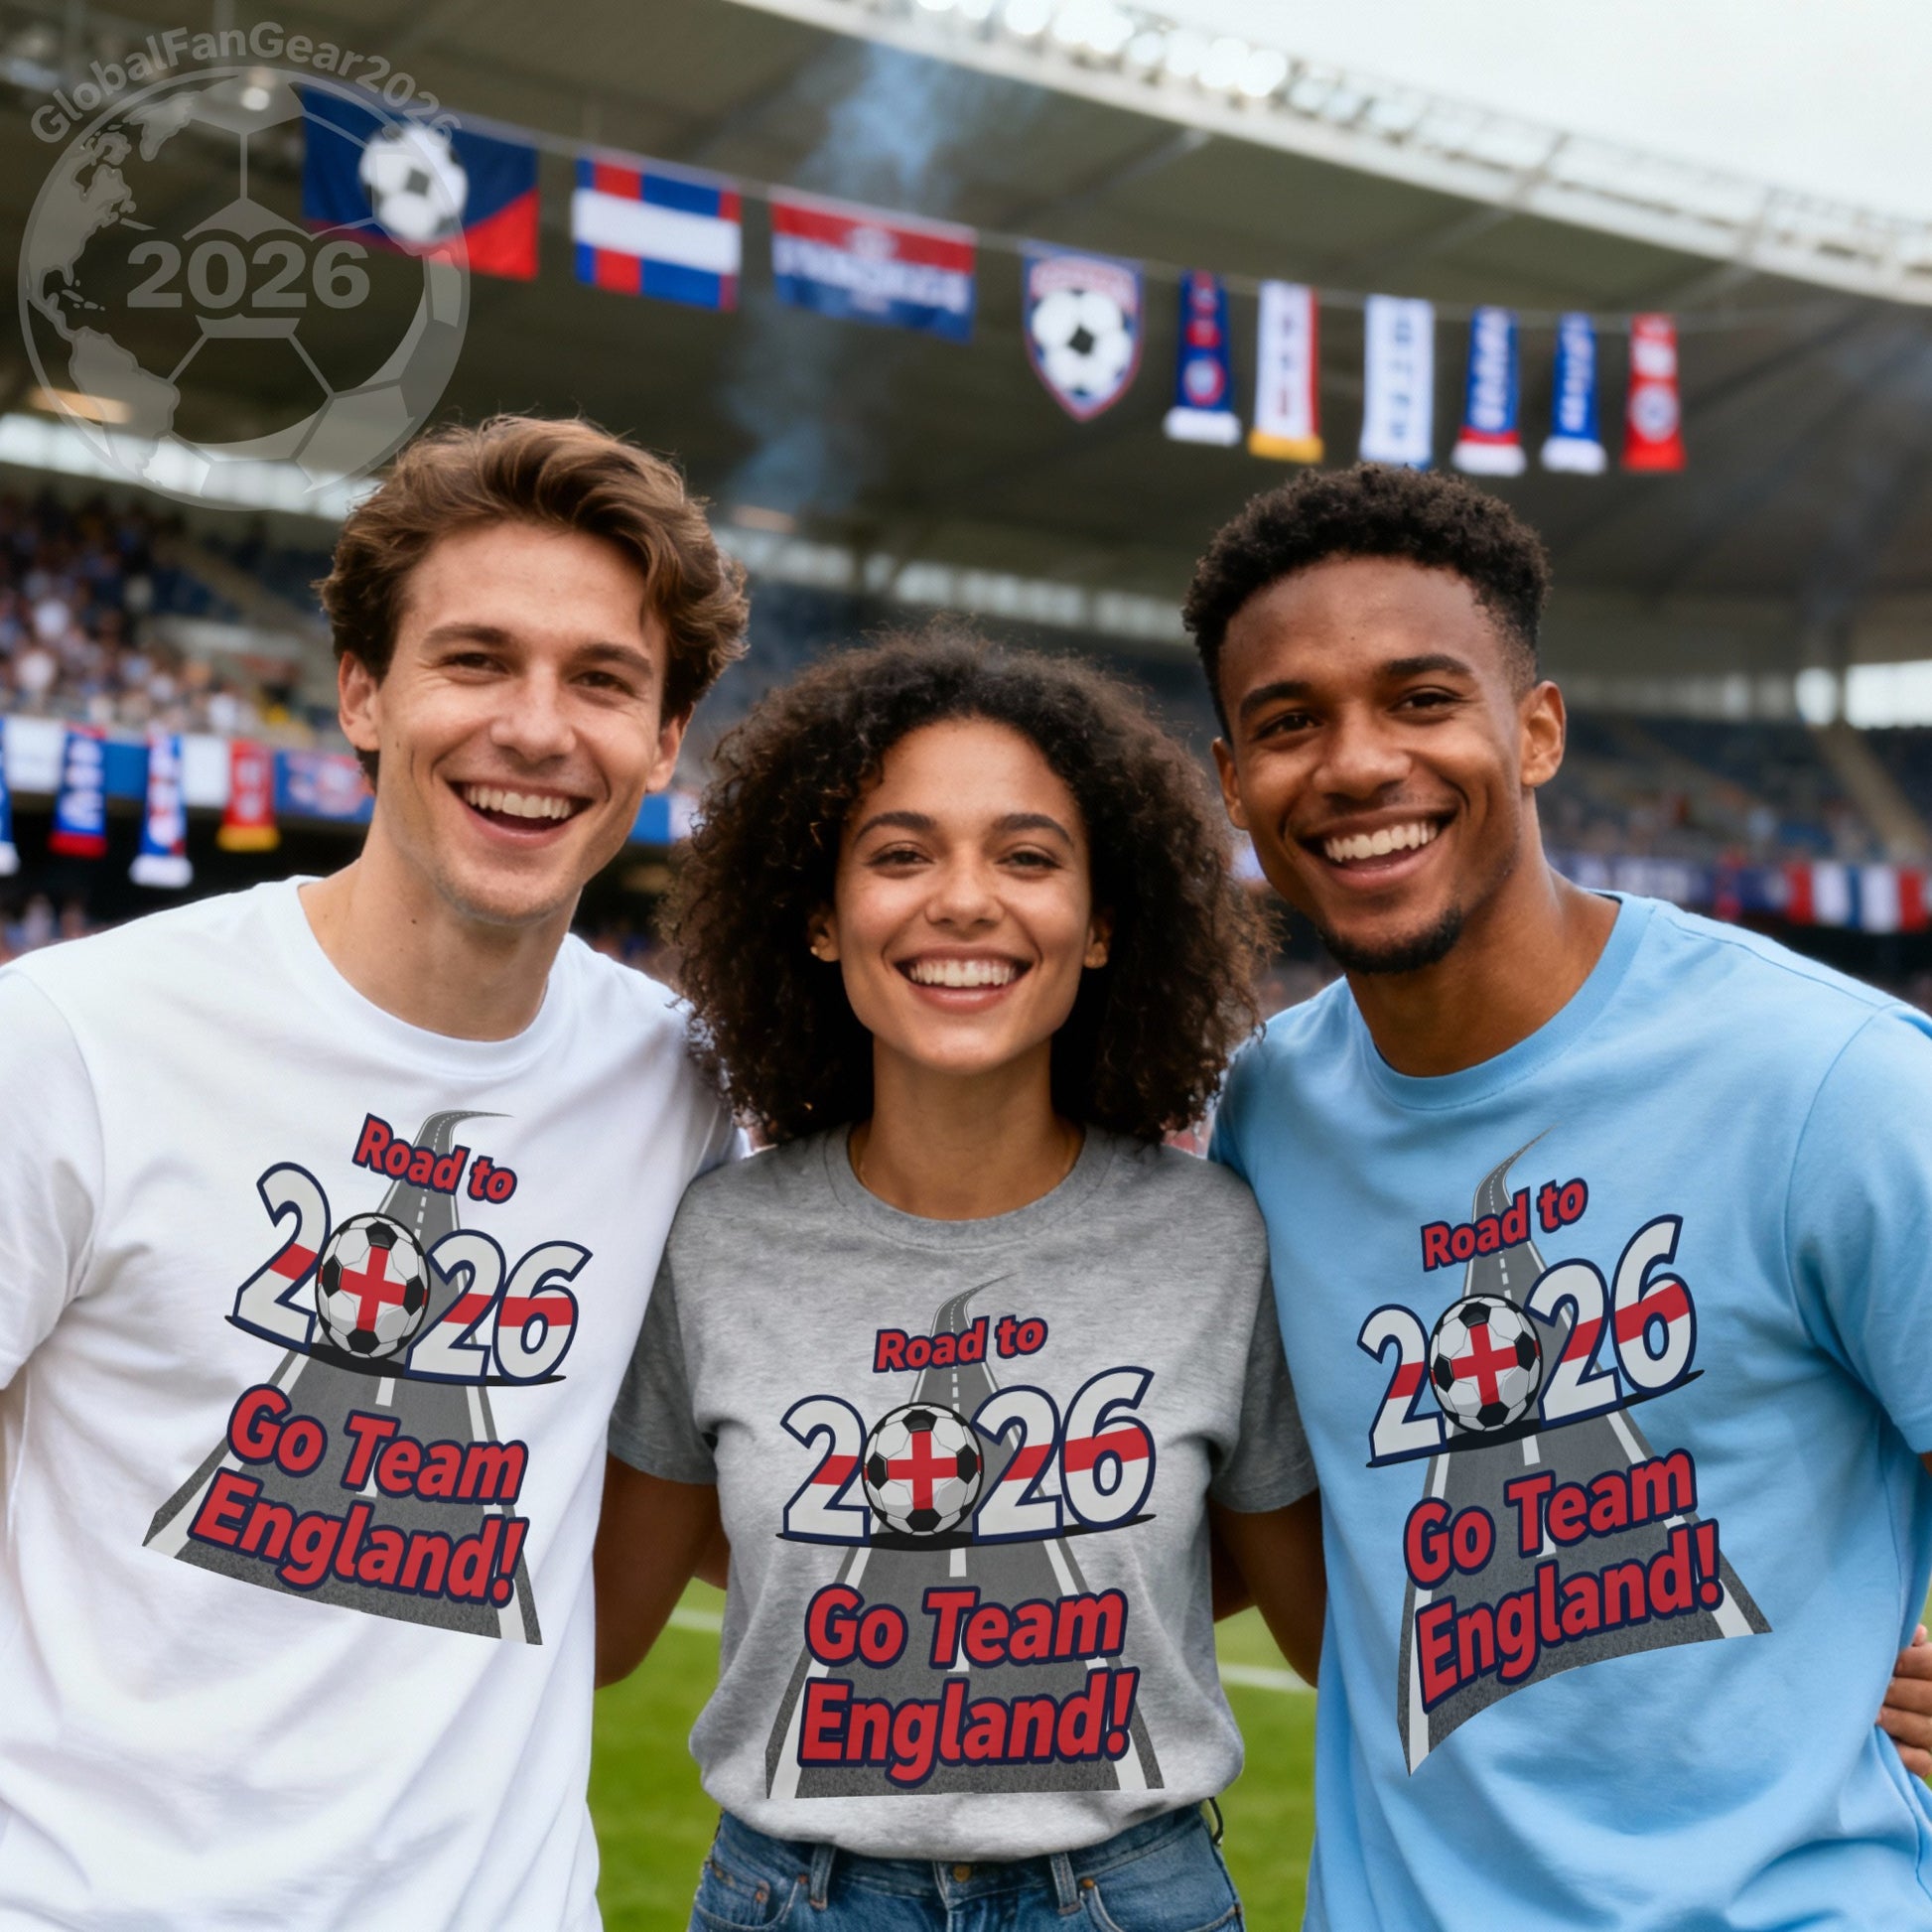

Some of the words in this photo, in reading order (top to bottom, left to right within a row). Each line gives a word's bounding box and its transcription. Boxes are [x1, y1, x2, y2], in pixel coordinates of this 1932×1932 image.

[353, 1113, 470, 1194] Road
[468, 1157, 516, 1203] to
[1422, 1187, 1531, 1271] Road
[1538, 1178, 1587, 1228] to
[874, 1316, 989, 1372] Road
[997, 1315, 1047, 1357] to
[227, 1384, 328, 1476] Go
[342, 1411, 528, 1505] Team
[188, 1467, 529, 1608] England!
[1405, 1497, 1494, 1588] Go
[1505, 1448, 1698, 1557] Team
[805, 1584, 907, 1669] Go
[922, 1587, 1128, 1669] Team
[1416, 1519, 1725, 1714] England!
[797, 1668, 1140, 1787] England!
